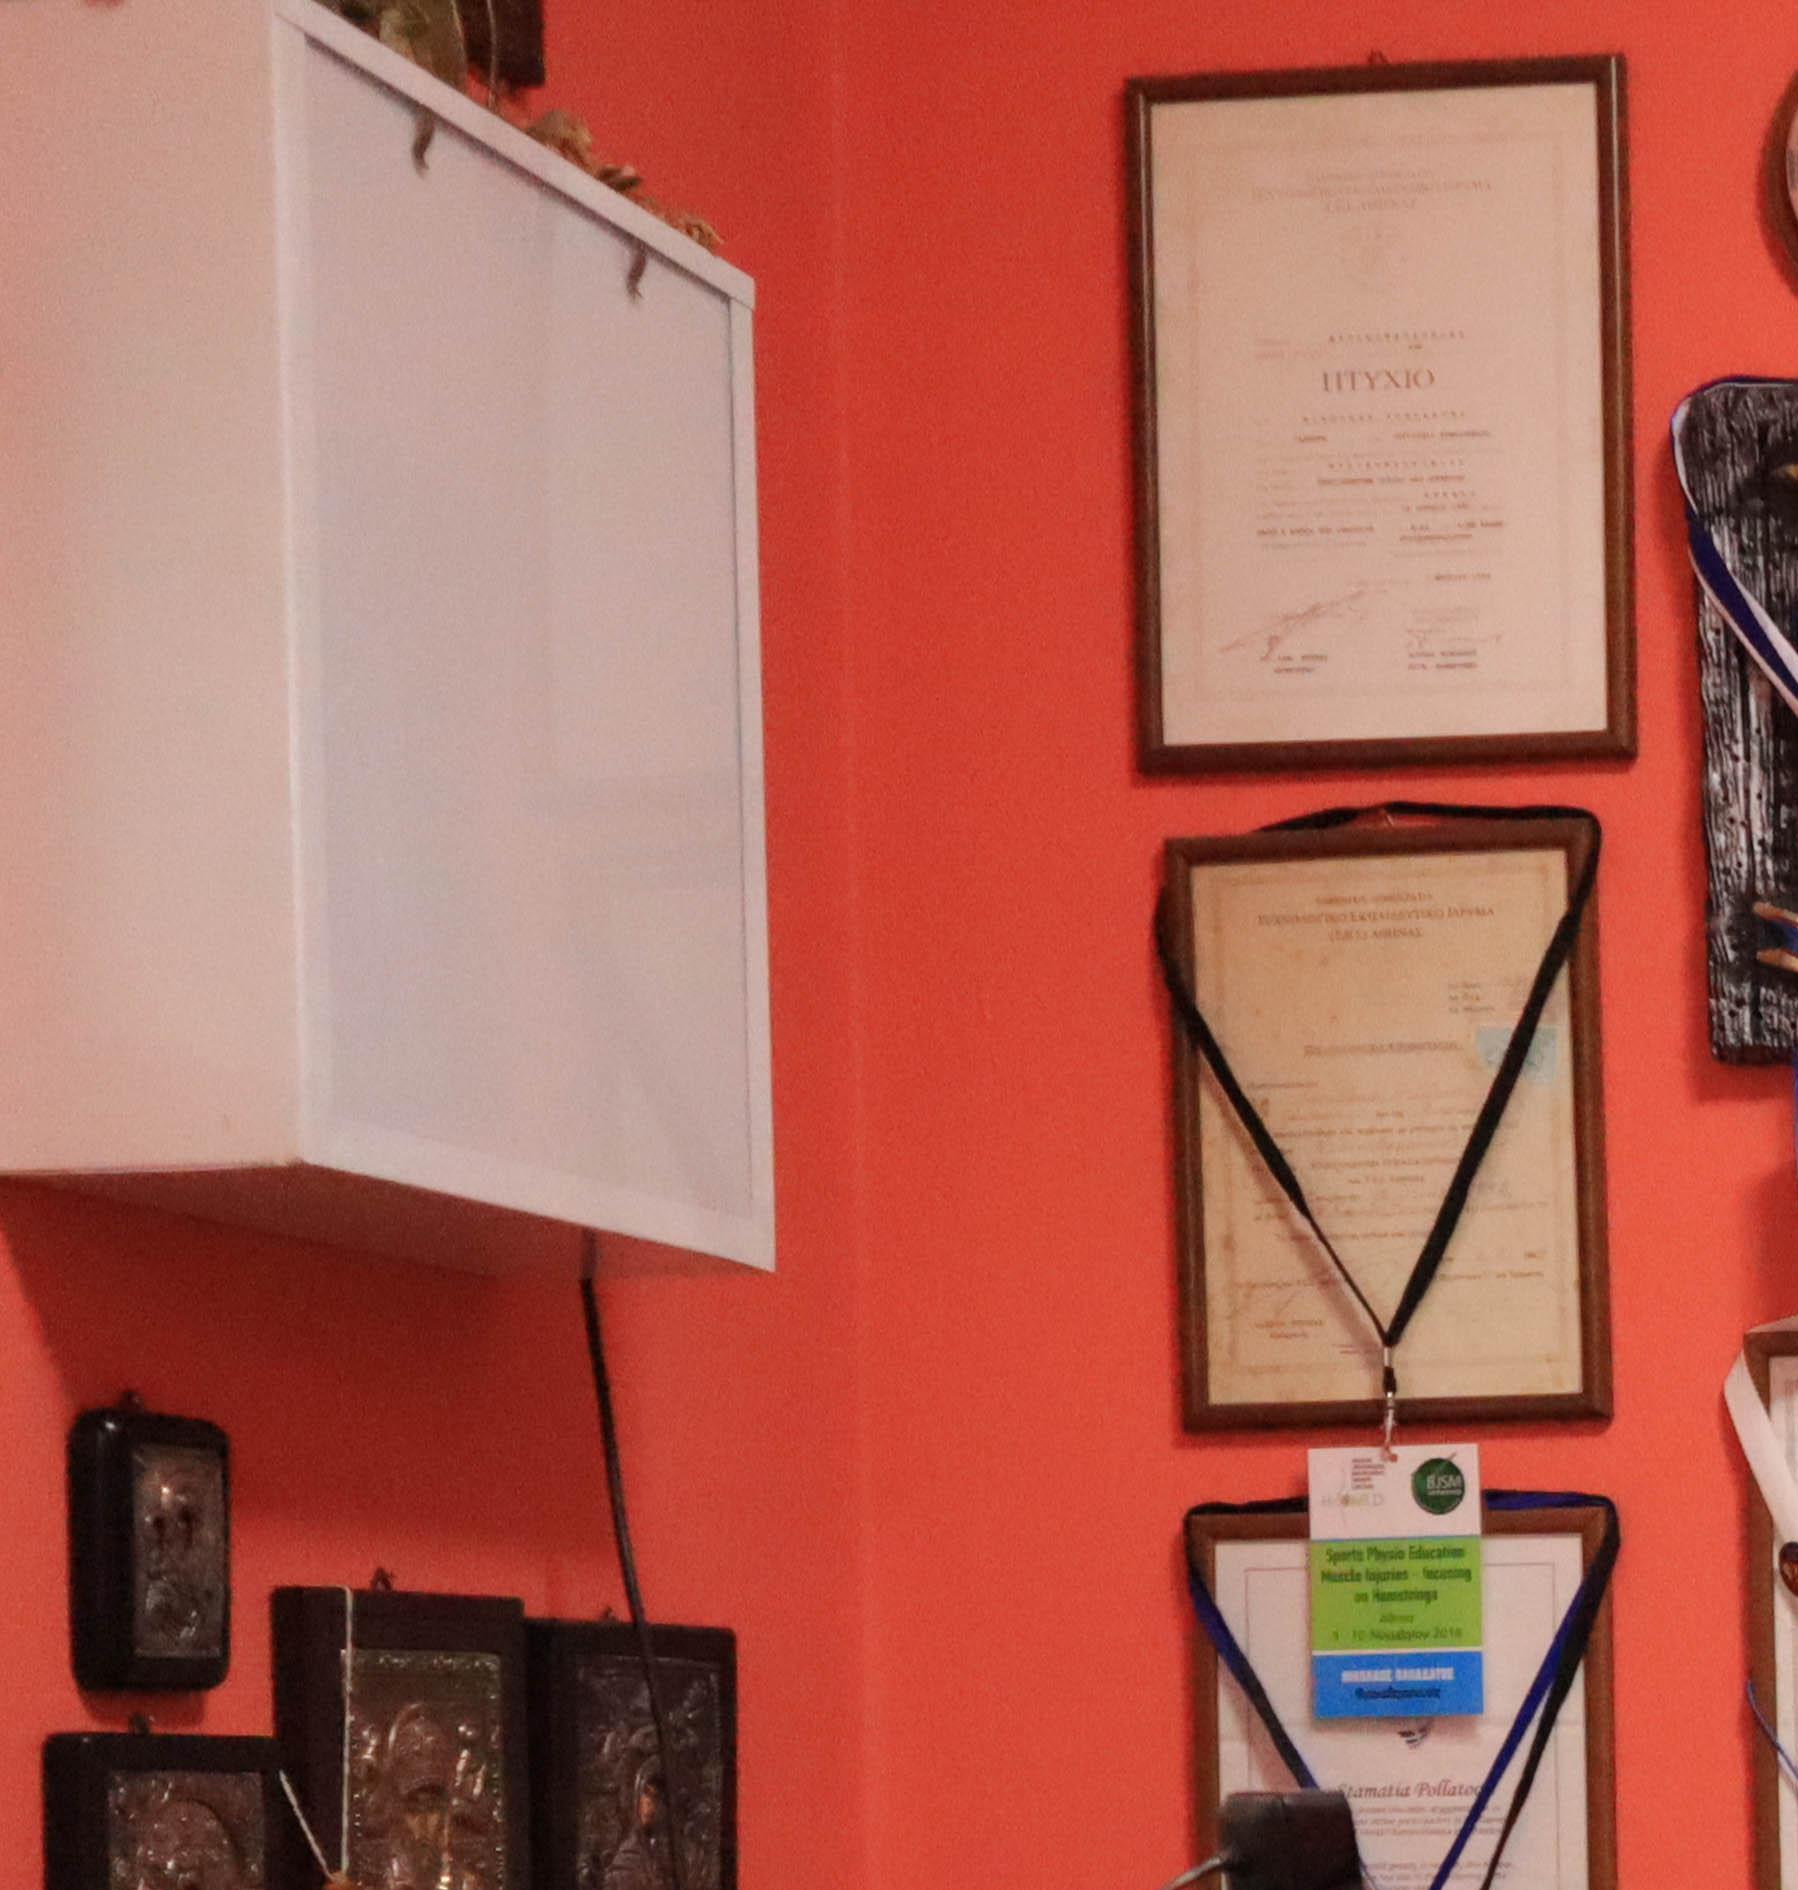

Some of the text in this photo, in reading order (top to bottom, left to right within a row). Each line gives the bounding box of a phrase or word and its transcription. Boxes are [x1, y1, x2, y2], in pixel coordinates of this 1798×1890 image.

[1322, 369, 1436, 392] ΠΤΥΧΙΟ
[1326, 1545, 1466, 1564] Sports Physio Education
